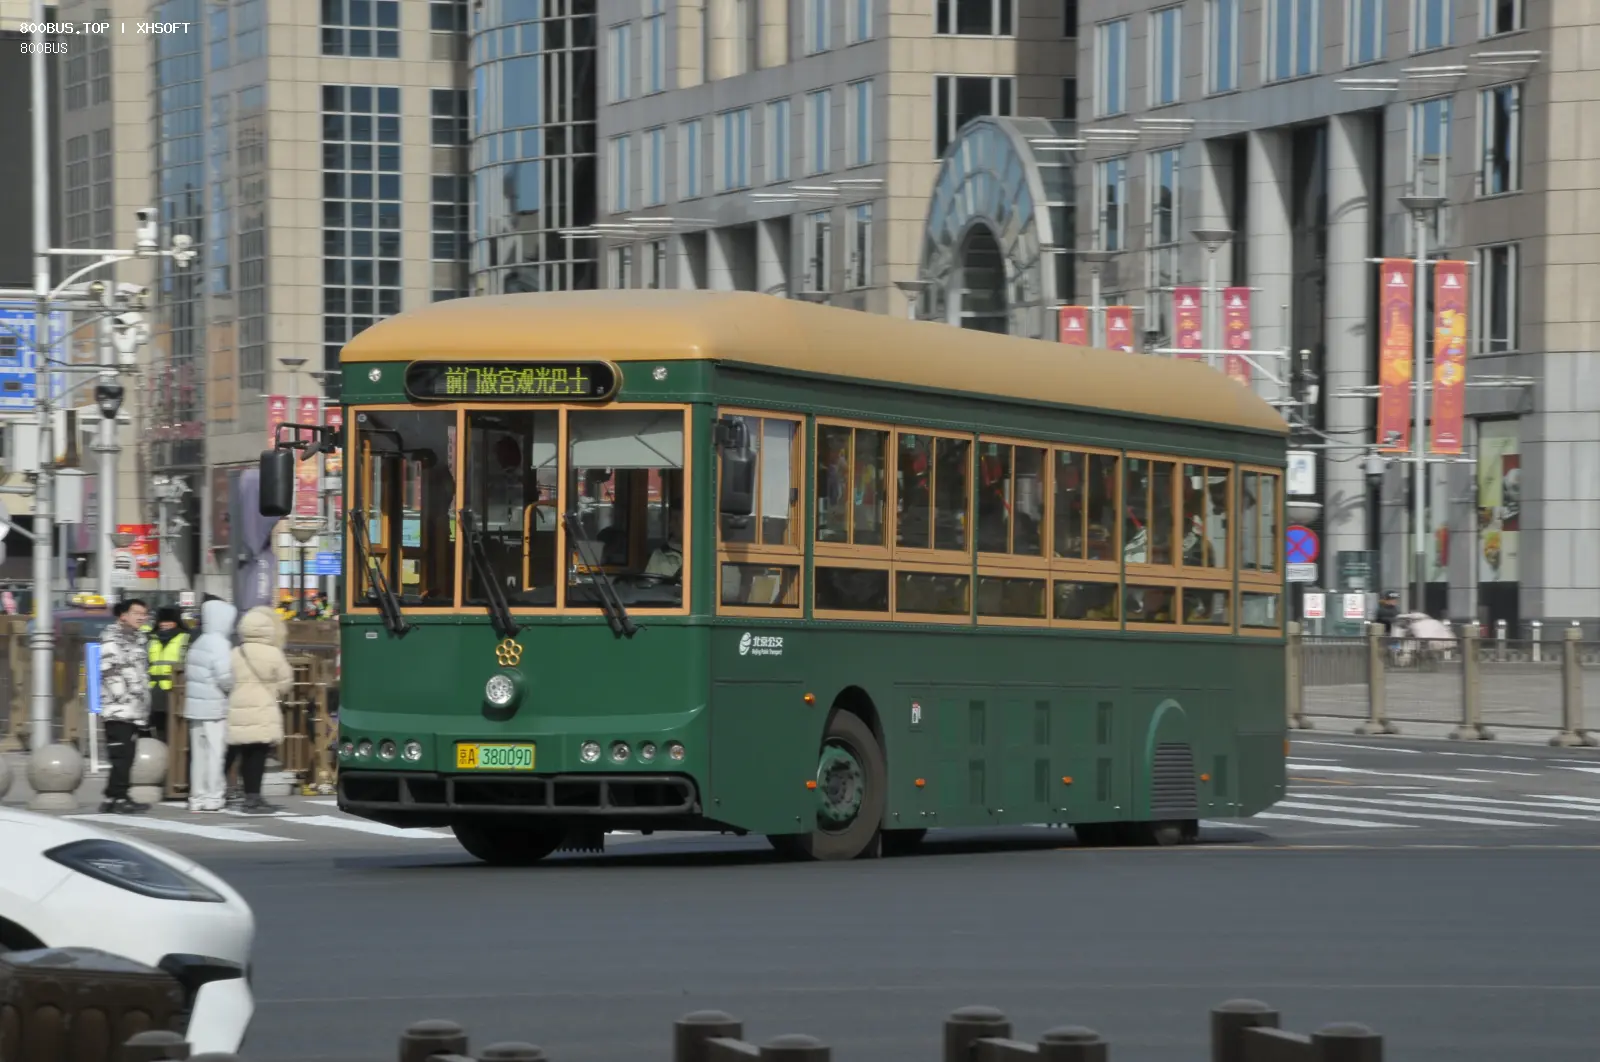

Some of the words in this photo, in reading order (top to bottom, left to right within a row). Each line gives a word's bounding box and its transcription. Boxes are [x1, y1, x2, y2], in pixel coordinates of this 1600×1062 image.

[445, 366, 588, 394] 前门故宫观光巴士
[752, 635, 783, 647] 北京公交
